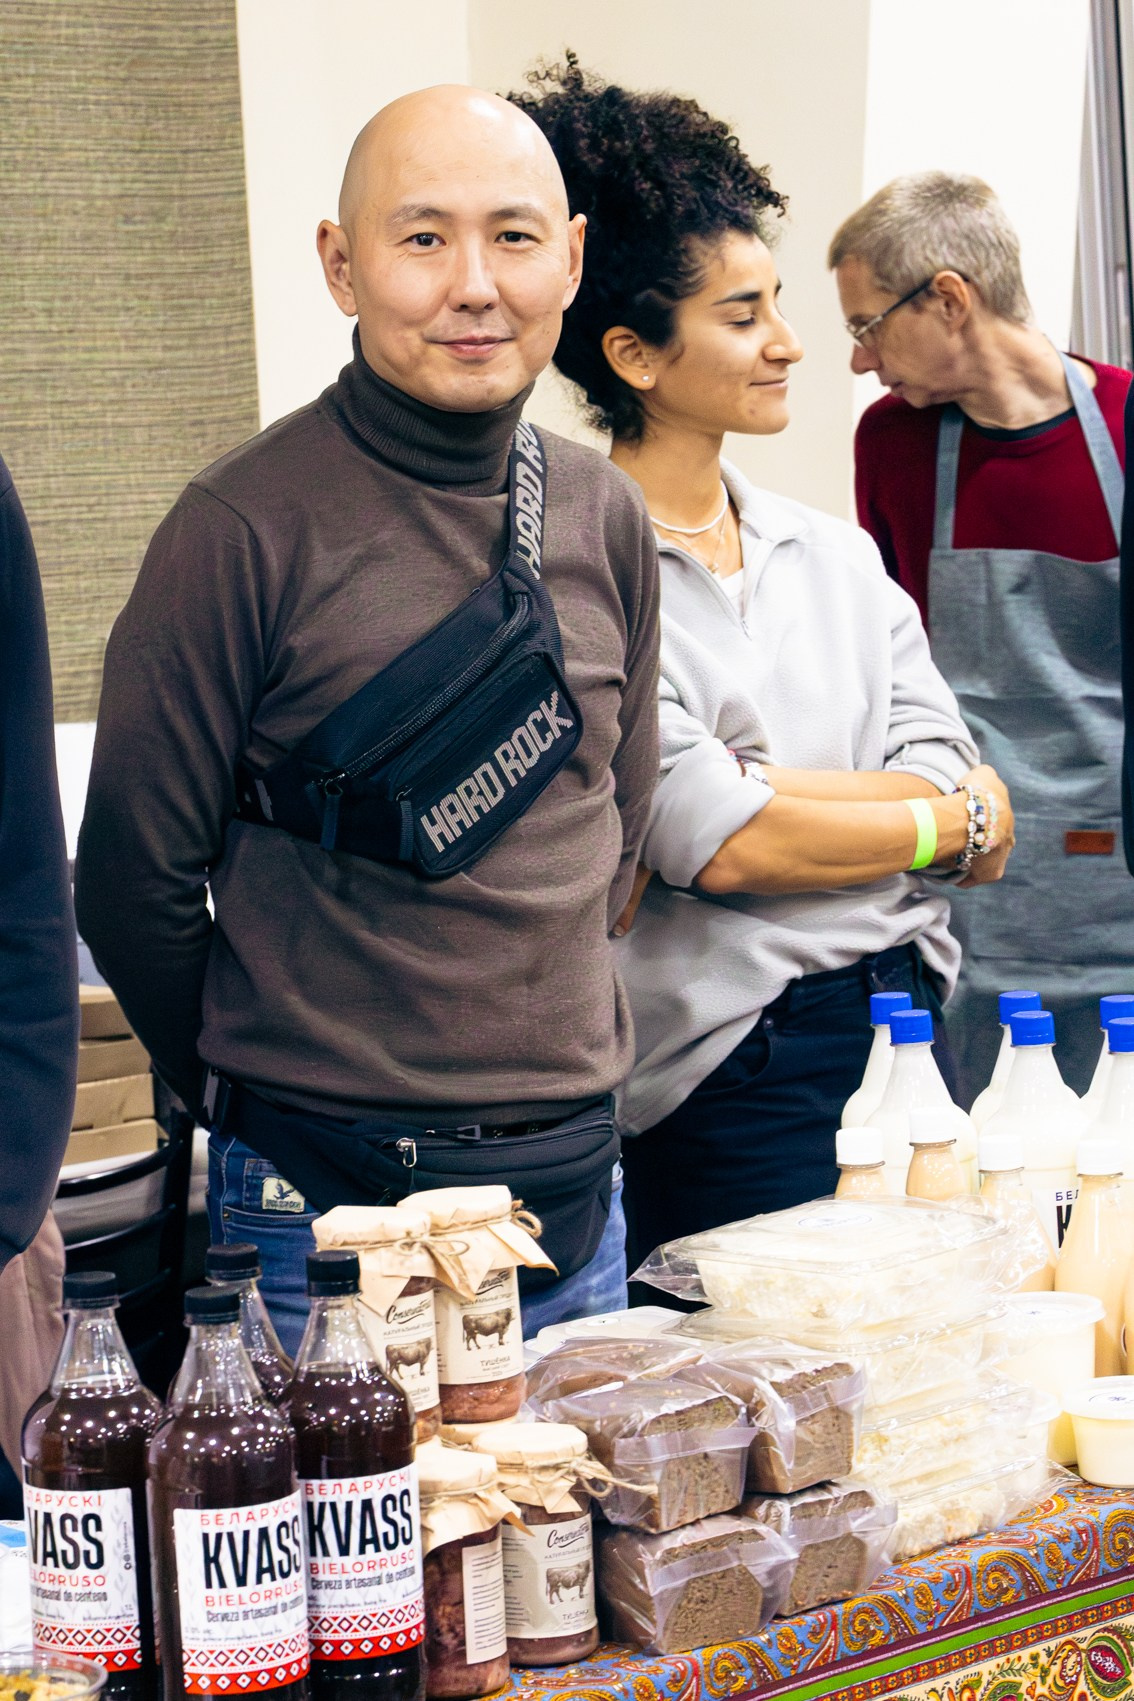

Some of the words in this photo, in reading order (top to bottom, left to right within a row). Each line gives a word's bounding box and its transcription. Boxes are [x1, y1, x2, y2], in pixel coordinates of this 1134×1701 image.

[515, 461, 544, 580] HARD
[420, 761, 506, 853] HARD
[493, 690, 574, 788] ROCK
[306, 1488, 413, 1557] KVASS
[202, 1514, 302, 1589] KVASS
[309, 1549, 415, 1575] BIELORRUSO
[205, 1578, 302, 1607] BIELORRUS
[311, 1577, 343, 1590] Cerveza
[345, 1572, 383, 1590] artesanal
[385, 1571, 394, 1584] de
[63, 1590, 73, 1601] de
[206, 1610, 240, 1622] Cerveza
[242, 1602, 278, 1620] artesanal
